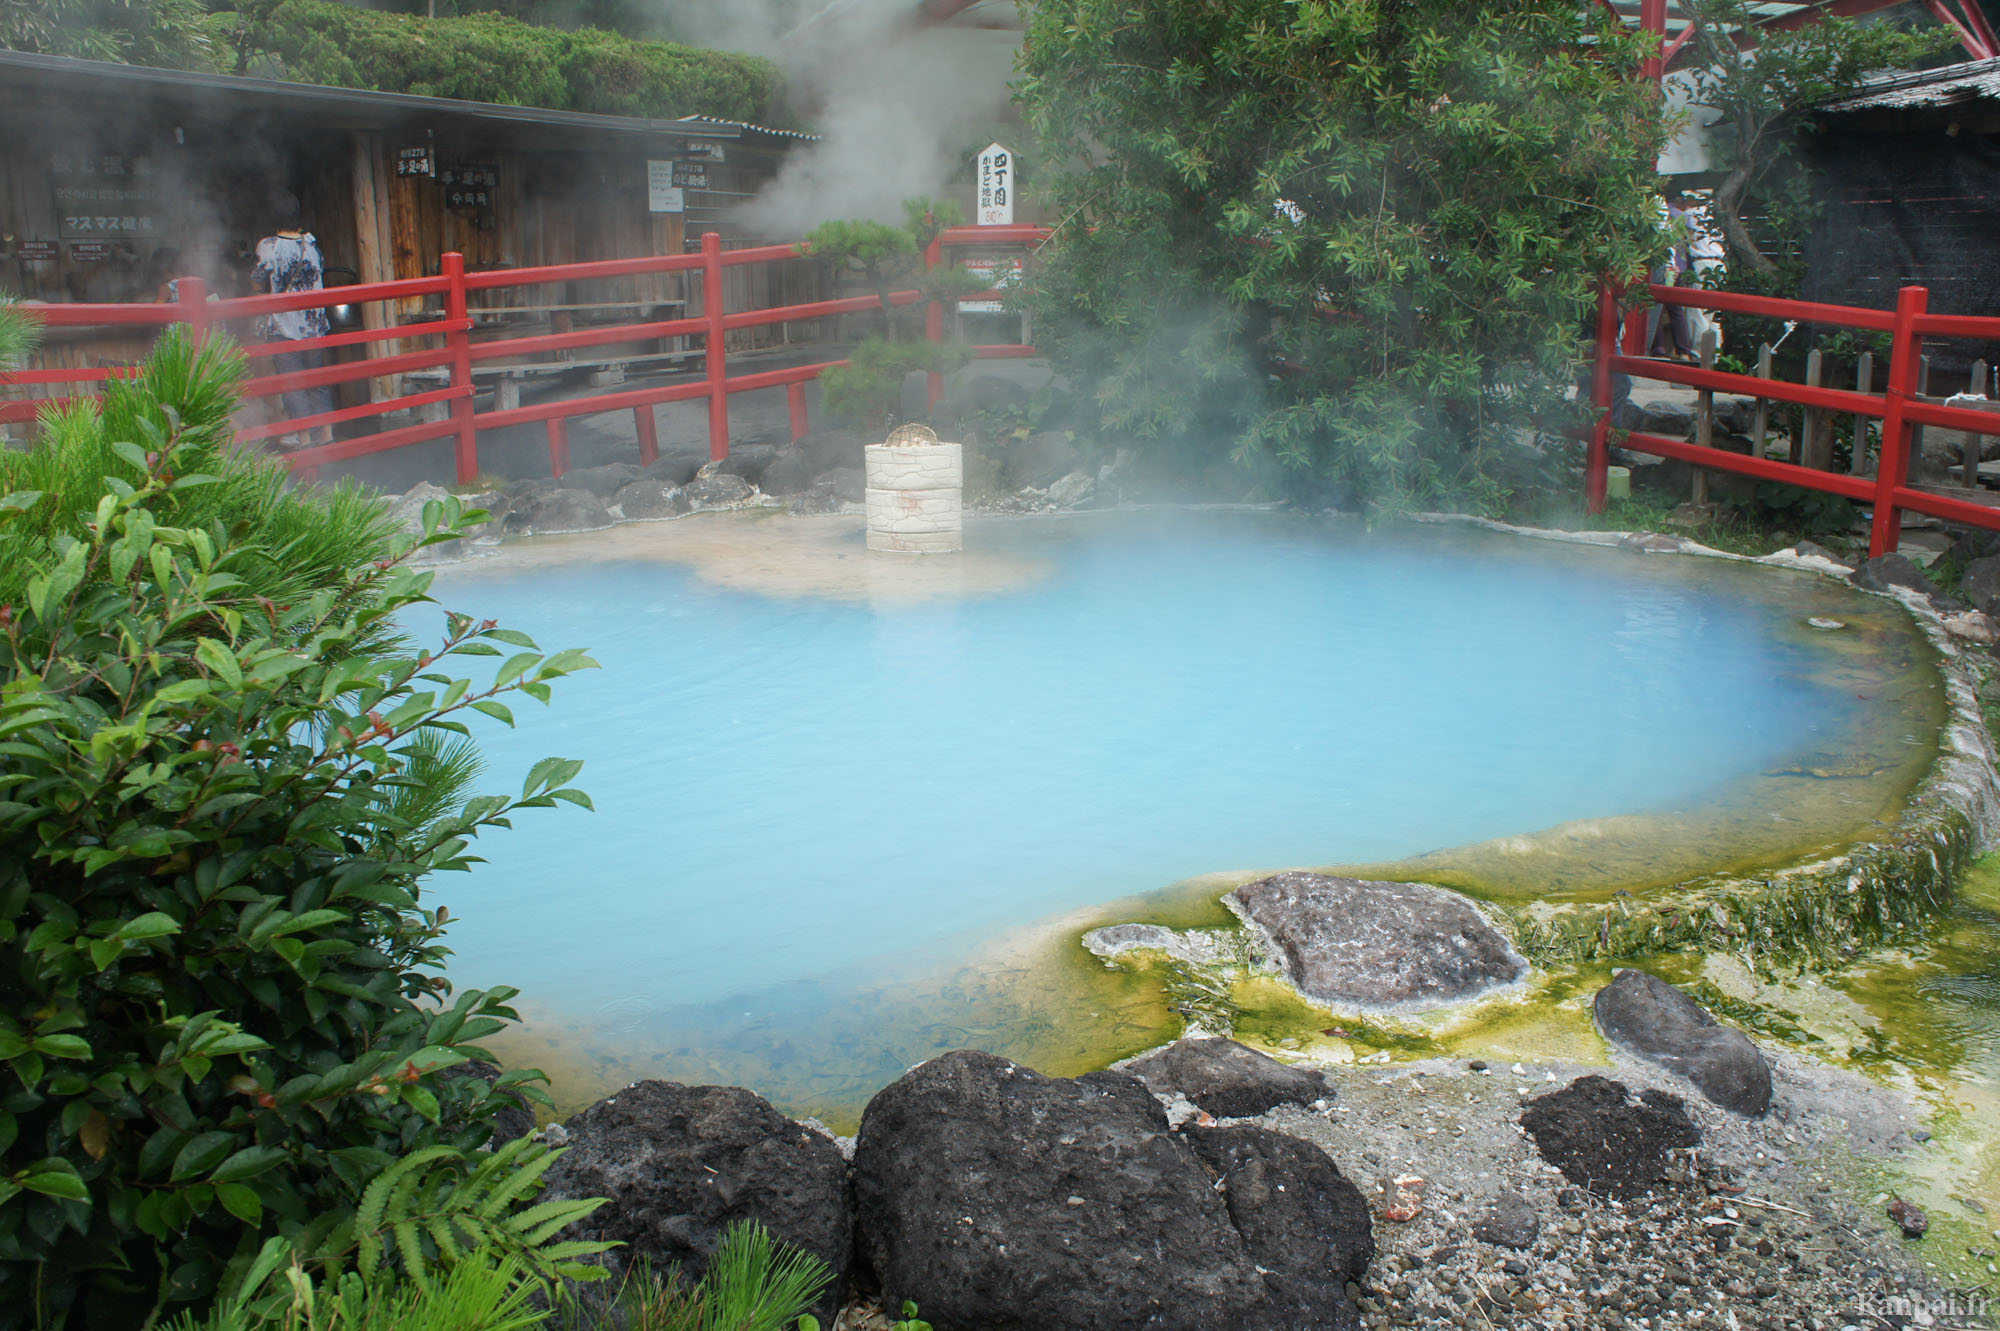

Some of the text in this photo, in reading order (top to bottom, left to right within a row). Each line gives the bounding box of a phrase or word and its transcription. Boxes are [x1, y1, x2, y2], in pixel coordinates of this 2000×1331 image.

[981, 155, 992, 208] かまど地獄
[994, 153, 1008, 207] 四丁目
